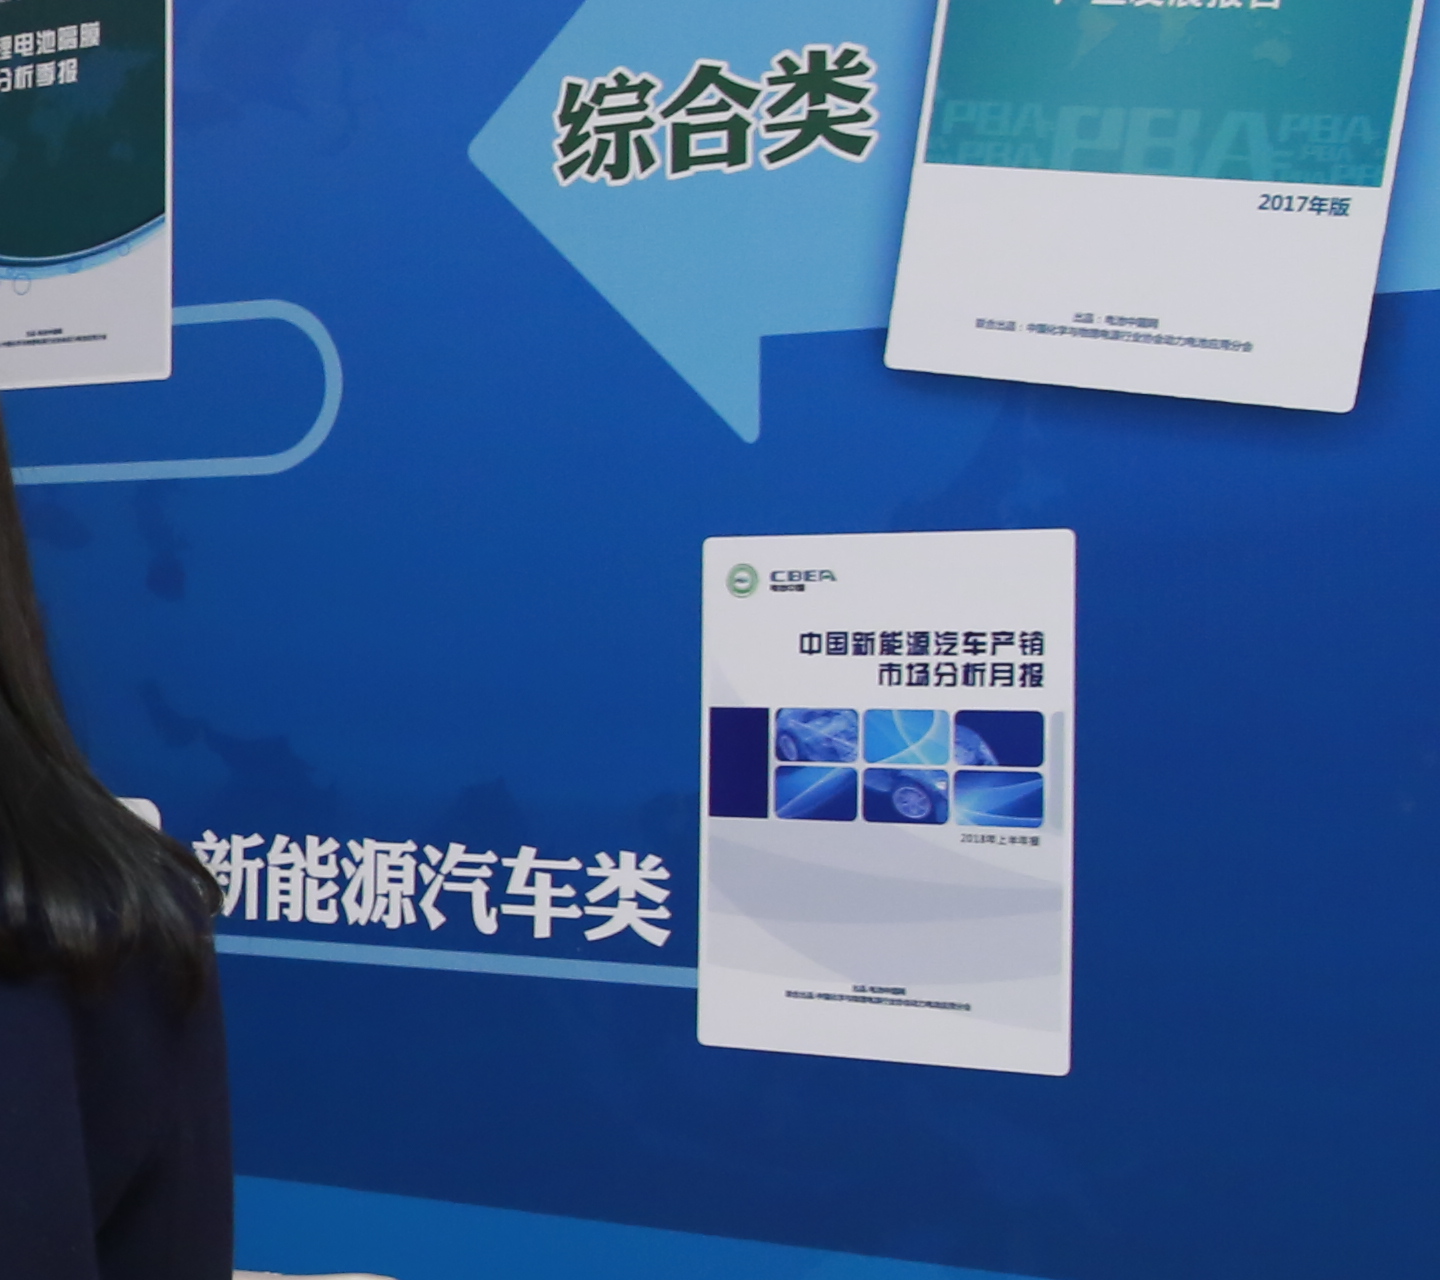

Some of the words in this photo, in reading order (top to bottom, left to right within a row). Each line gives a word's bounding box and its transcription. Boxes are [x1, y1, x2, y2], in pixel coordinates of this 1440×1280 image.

[554, 44, 877, 187] 综合类
[1257, 193, 1352, 218] 2017年版
[769, 569, 837, 582] CBEA
[799, 631, 1045, 657] 中国新能源汽车产销
[878, 662, 1045, 688] 市场分析月报
[191, 829, 672, 948] 新能源汽车类
